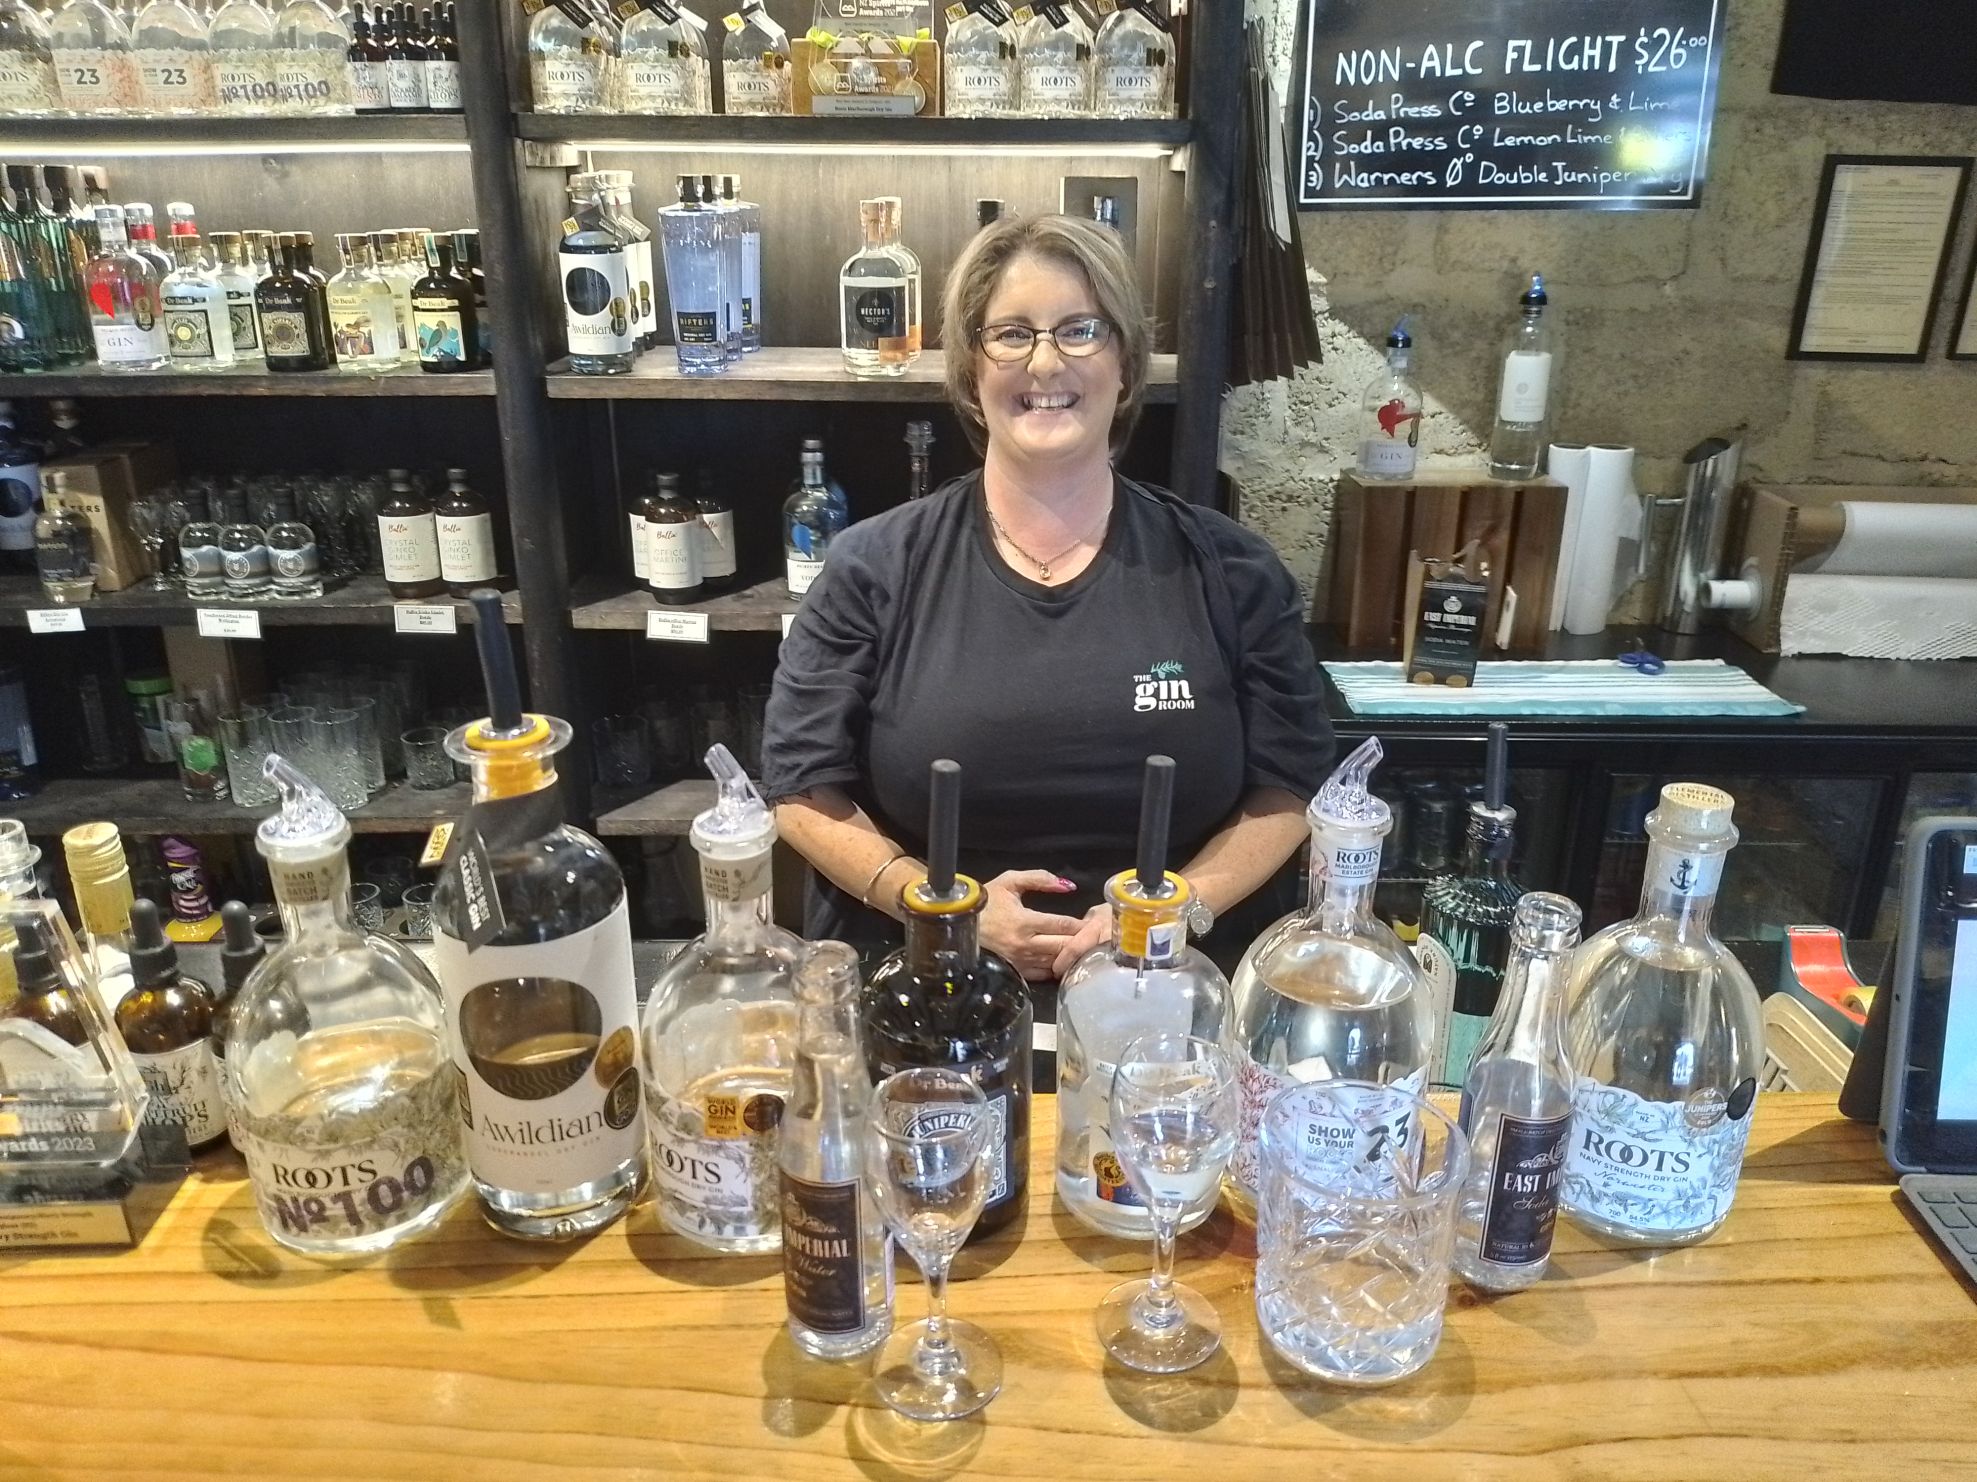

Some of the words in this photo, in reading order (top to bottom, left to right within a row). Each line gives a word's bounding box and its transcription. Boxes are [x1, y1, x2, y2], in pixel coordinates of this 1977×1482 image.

[1335, 40, 1485, 87] NON-ALC
[1504, 34, 1626, 75] FLIGHT
[74, 68, 101, 85] 23
[161, 68, 188, 85] 23
[221, 72, 256, 83] ROOTS
[548, 71, 585, 81] ROOTS
[635, 73, 672, 84] ROOTS
[965, 75, 1000, 86] ROOTS
[1041, 75, 1077, 86] ROOTS
[1116, 75, 1151, 86] ROOTS
[737, 81, 770, 91] ROOTS
[1333, 99, 1387, 124] Soda
[1391, 93, 1442, 119] Press
[1494, 88, 1603, 122] Blueberry
[1608, 93, 1624, 113] &
[1332, 129, 1385, 155] Soda
[1389, 126, 1448, 152] Press
[1493, 127, 1562, 147] Lemon
[1566, 123, 1613, 144] Lime
[1334, 160, 1437, 189] Warners
[1478, 160, 1549, 185] Double
[1551, 161, 1632, 194] Juniper
[107, 337, 134, 347] GIN
[1133, 674, 1152, 682] THE
[1133, 680, 1195, 712] gin
[1158, 700, 1195, 710] ROOM
[1336, 848, 1380, 864] ROOTS
[283, 871, 314, 880] HAND
[467, 903, 482, 932] GIN
[707, 1104, 736, 1117] GIN
[1684, 1101, 1729, 1113] JUNIPERS
[1639, 1115, 1651, 1123] NZ
[481, 1110, 604, 1146] Awildian
[1308, 1123, 1356, 1140] SHOW
[1307, 1135, 1322, 1146] US
[1323, 1138, 1355, 1149] YOUR
[1366, 1110, 1412, 1163] 23
[50, 1137, 96, 1151] 2023
[1583, 1128, 1691, 1174] ROOTS
[1580, 1151, 1602, 1166] NAVY
[1603, 1162, 1651, 1181] STRENGTH
[271, 1158, 379, 1190] ROOTS
[1503, 1171, 1543, 1194] EAST
[1608, 1208, 1621, 1217] 700
